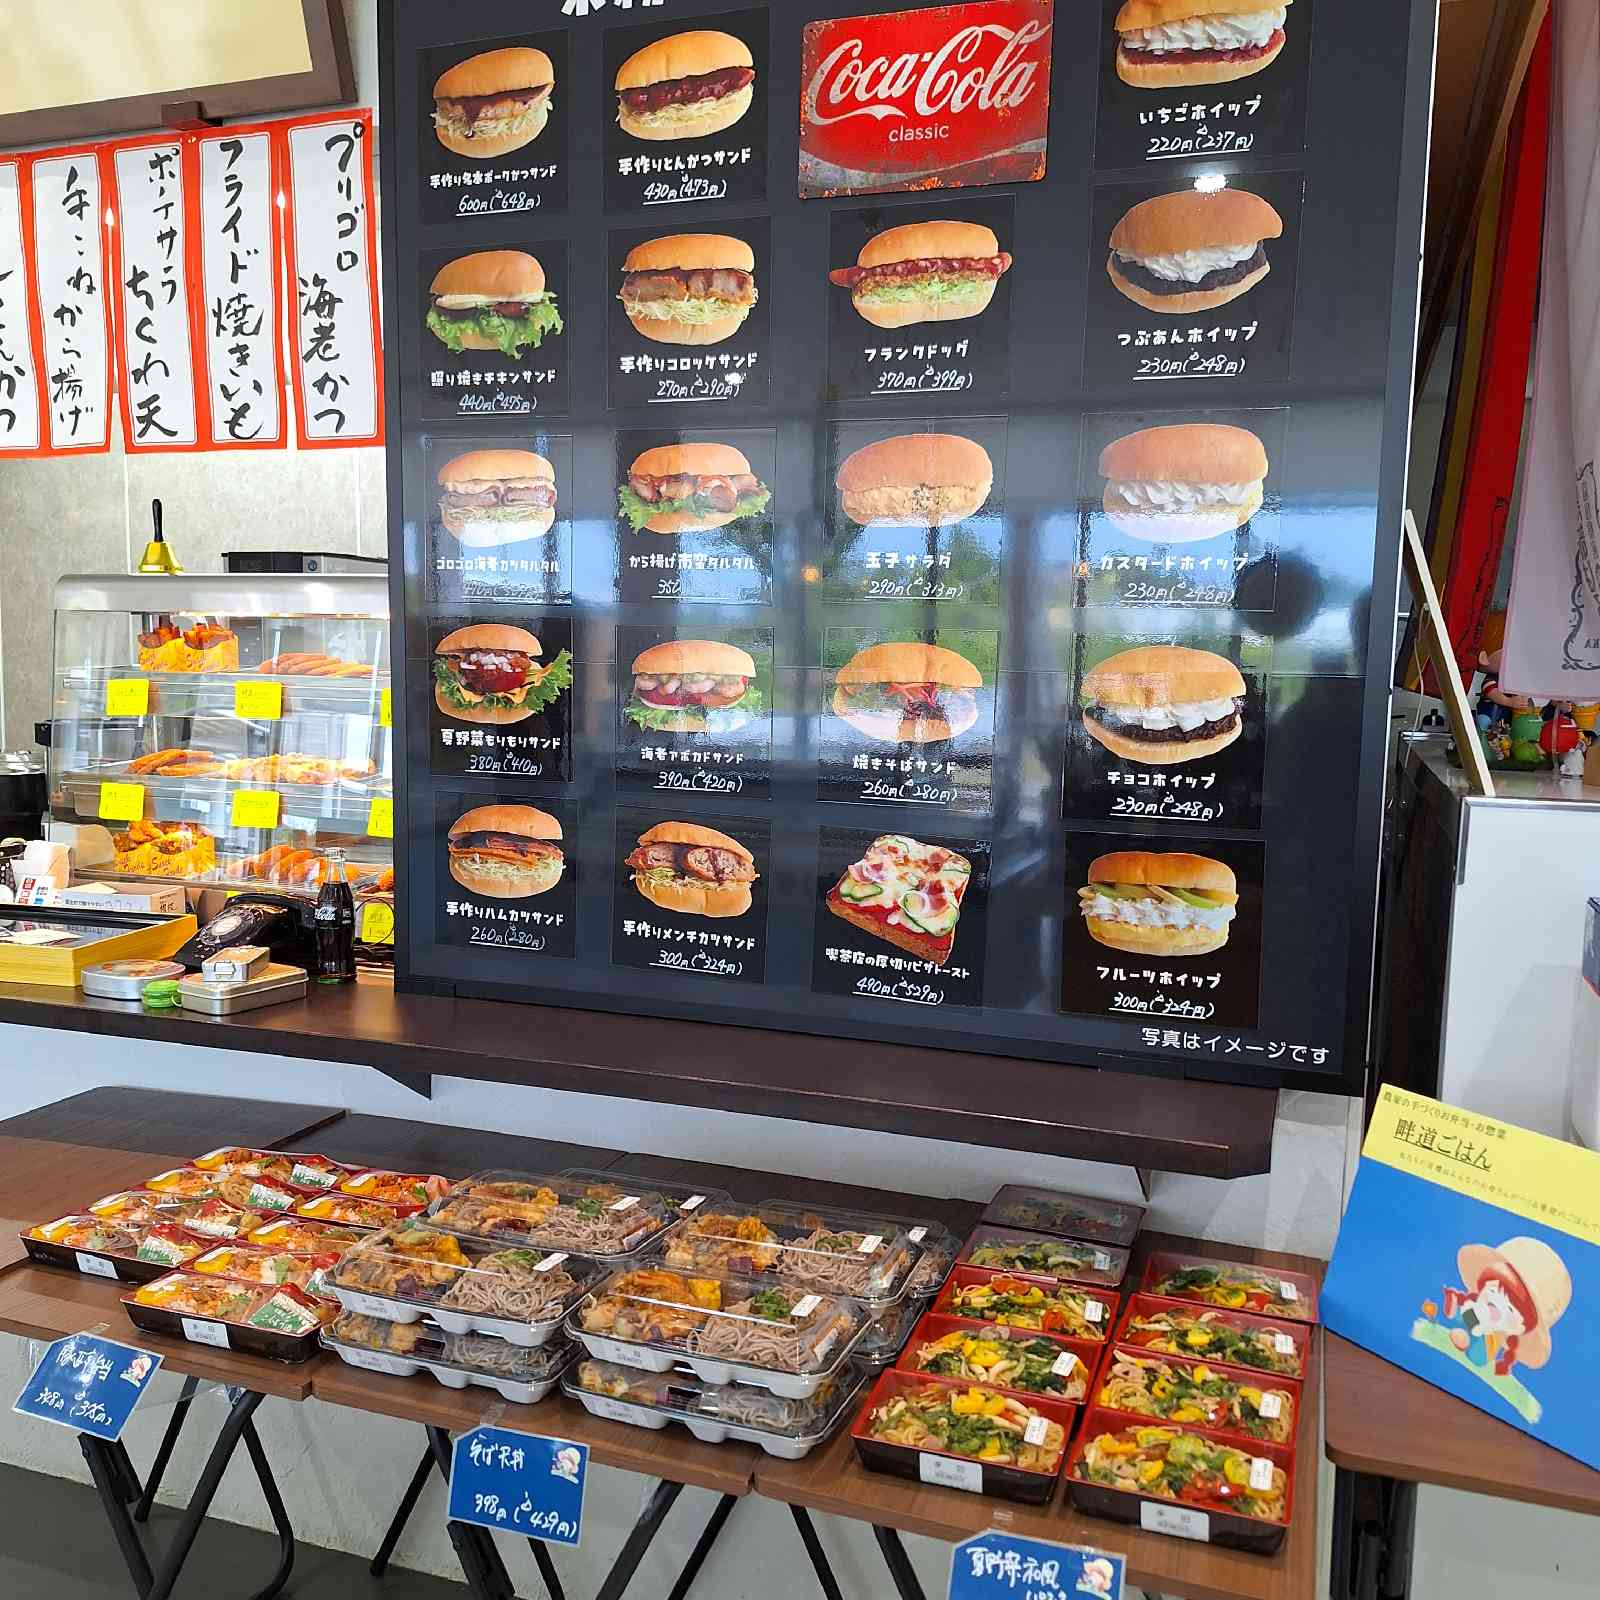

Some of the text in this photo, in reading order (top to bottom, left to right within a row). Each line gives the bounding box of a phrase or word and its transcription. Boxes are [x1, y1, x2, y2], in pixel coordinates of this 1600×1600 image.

[808, 19, 1051, 125] Coca-Cola
[1139, 95, 1262, 126] いちごホイップ
[888, 123, 950, 143] classic
[618, 147, 752, 177] 手作りとんかつサンド
[429, 164, 557, 190] 手作り名水ポークかつサンド
[212, 139, 264, 440] フライド焼きいも
[1117, 321, 1259, 347] つぶあんホイップ
[126, 264, 178, 438] ちくわ天
[299, 272, 350, 434] 海老かつ
[863, 341, 969, 361] フランクドッグ
[619, 353, 758, 375] 手作りコロッケサンド
[430, 369, 557, 388] 照り焼きチキンサンド
[865, 551, 952, 570] 玉子サラダ
[1100, 553, 1249, 572] カスタードホイップ
[440, 728, 561, 750] 夏野菜もりもりサンド
[640, 747, 745, 765] 海老アボカドサンド
[852, 755, 957, 777] 焼きそばサンド
[1106, 771, 1216, 790] チョコホイップ
[446, 901, 564, 926] 手作りハムカツサンド
[623, 920, 755, 951] 手作りメンチカツサンド
[1096, 966, 1222, 989] フルーツホイップ
[1141, 1027, 1330, 1065] 写真はイメージです
